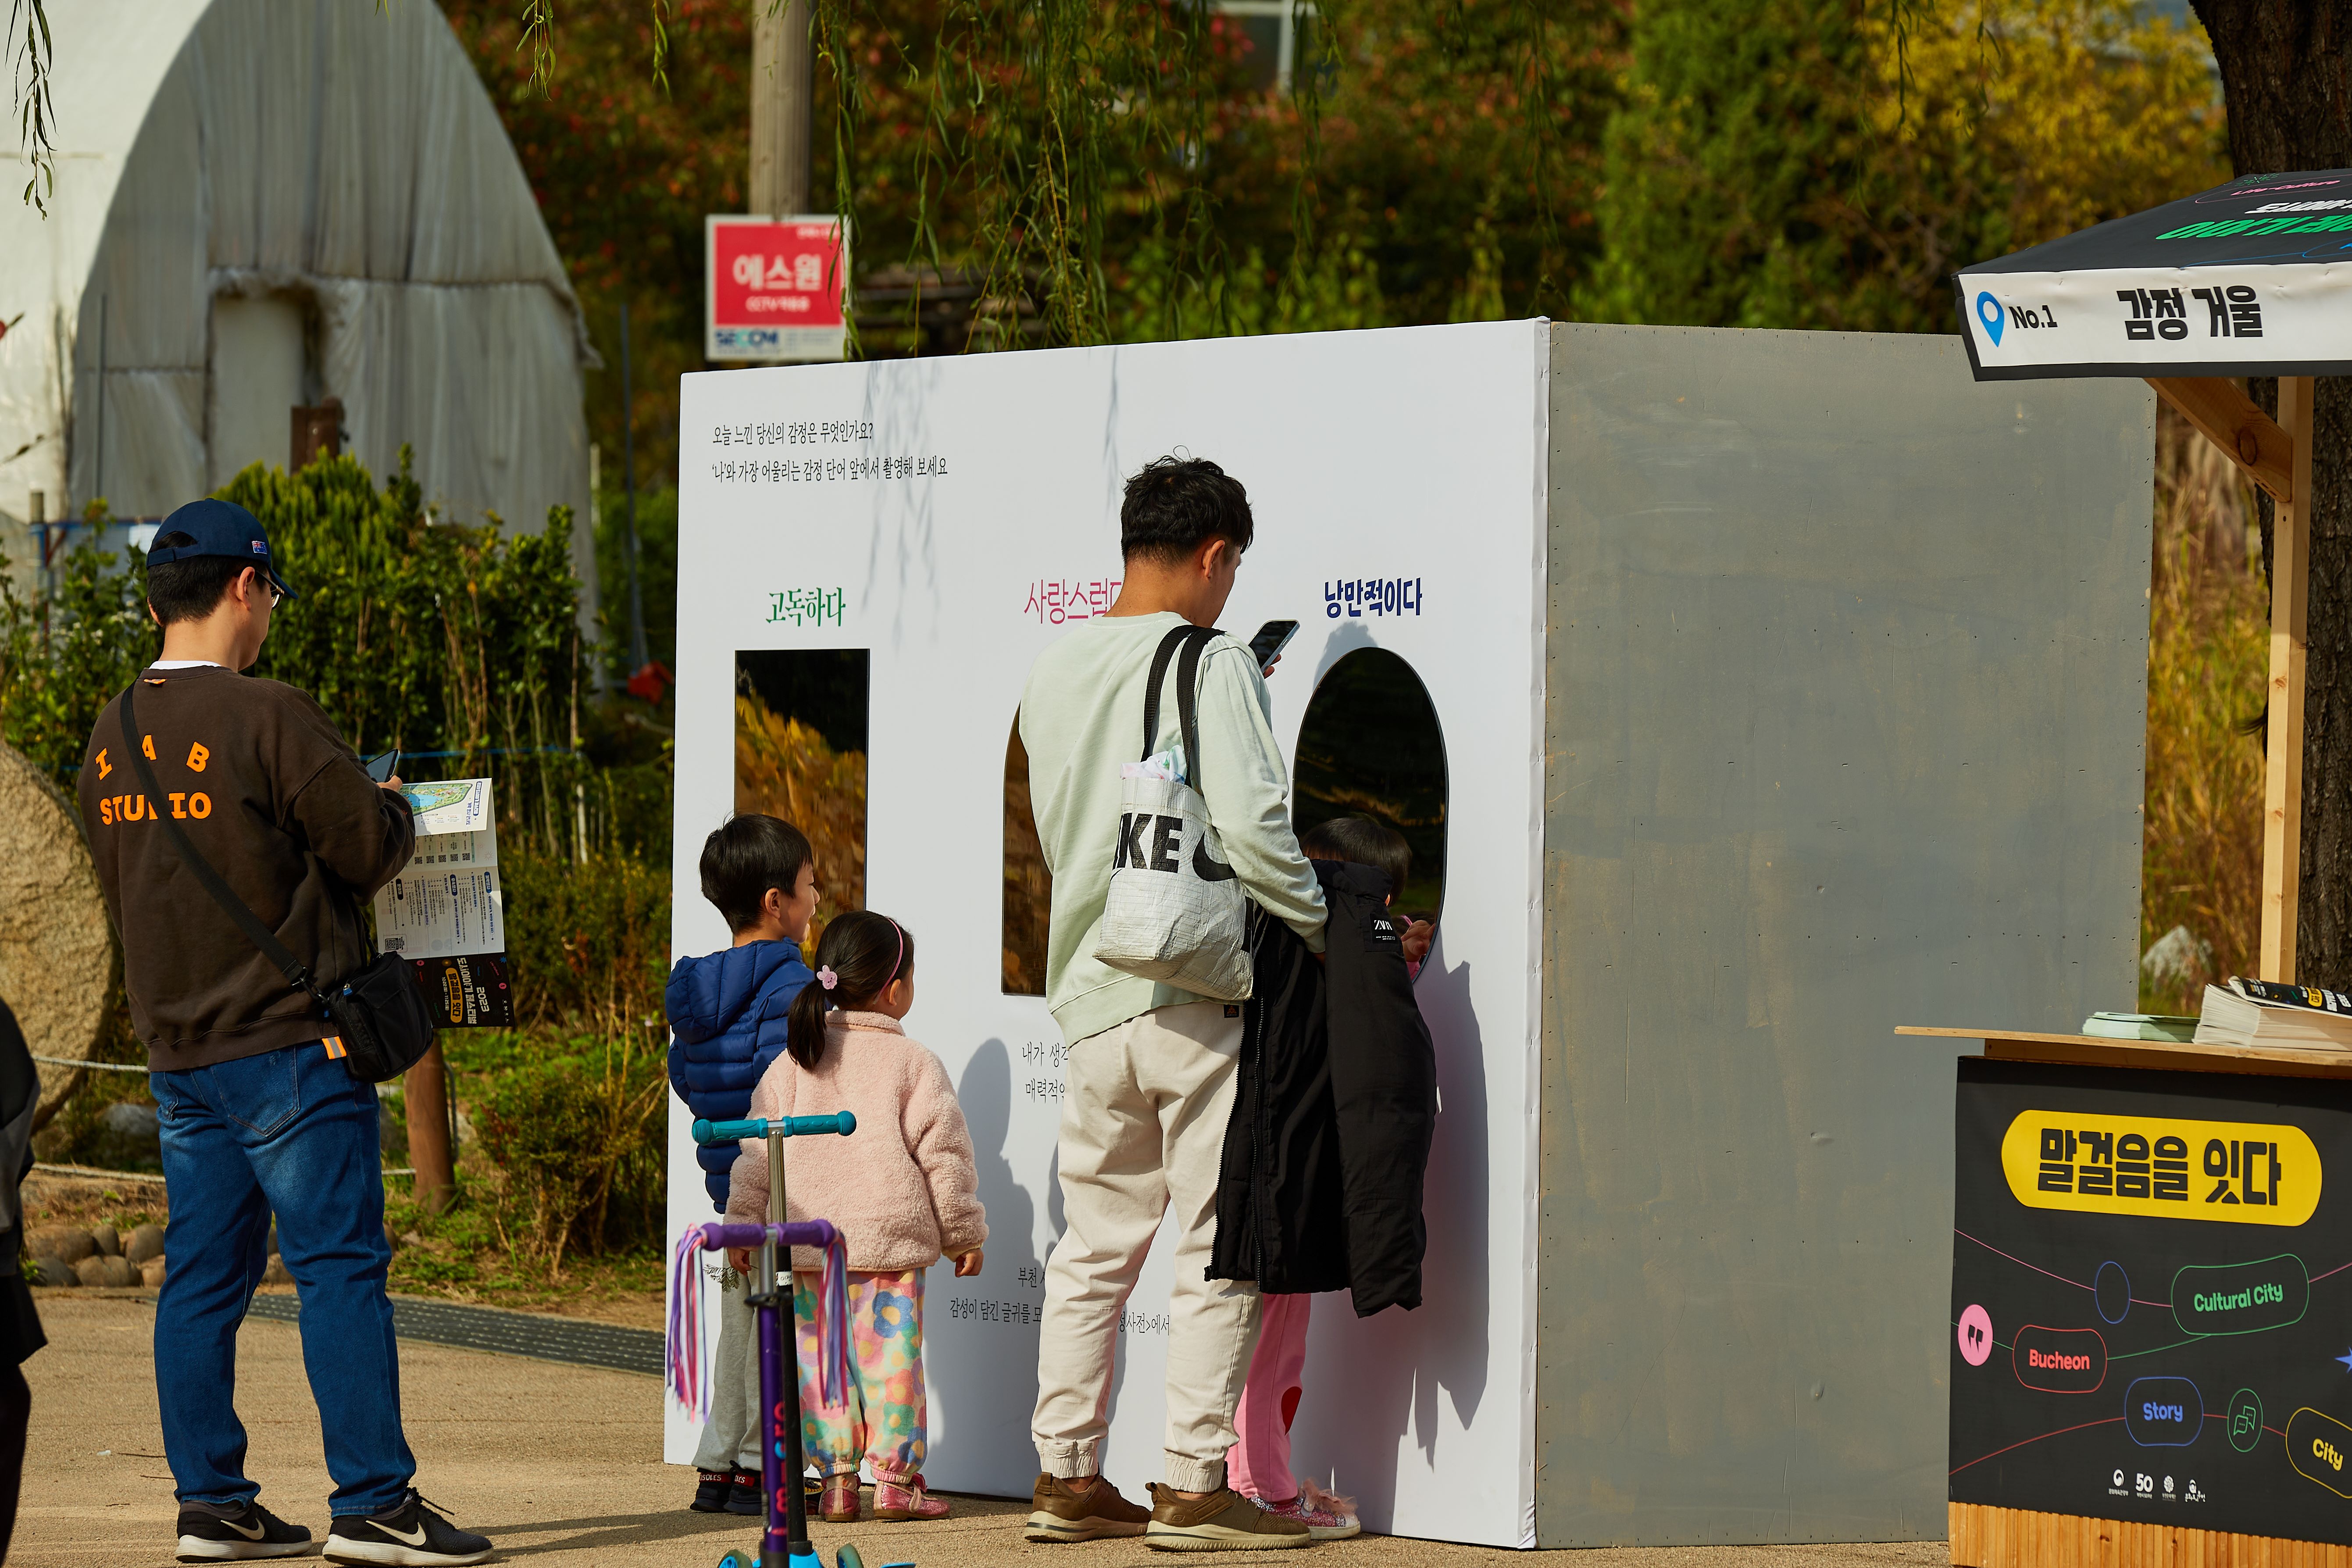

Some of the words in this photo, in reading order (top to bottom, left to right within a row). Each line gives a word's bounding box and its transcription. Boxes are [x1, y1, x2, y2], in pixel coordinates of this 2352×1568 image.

[2244, 199, 2352, 214] 도시이야
[2008, 305, 2058, 329] No.1
[2116, 288, 2188, 341] 감정
[2191, 285, 2263, 338] 거울
[713, 425, 732, 446] 오늘
[734, 423, 753, 445] 느낀
[757, 422, 784, 445] 당신의
[788, 422, 817, 444] 감정은
[820, 420, 873, 443] 무엇인가요?
[739, 461, 759, 483] 가장
[762, 460, 800, 482] 어울리는
[803, 459, 822, 481] 감정
[827, 458, 845, 480] 단어
[850, 457, 879, 480] 앞에서
[883, 456, 913, 479] 촬영해
[917, 455, 948, 476] 보세요
[766, 587, 846, 627] 고독하다
[1324, 577, 1423, 619] 낭만적이다
[1374, 919, 1393, 931] ZARA
[448, 972, 460, 1000] 말걸음을
[457, 957, 474, 993] 도시이야기
[452, 1002, 461, 1017] 잇다
[476, 987, 490, 1012] 2023
[1022, 1041, 1044, 1067] 내가
[2038, 1129, 2188, 1201] 말걸음을
[2203, 1139, 2282, 1206] 잇다
[1017, 1267, 1037, 1288] 부천
[950, 1297, 977, 1320] 감성이
[981, 1300, 999, 1321] 담긴
[1001, 1302, 1031, 1324] 글귀를
[2194, 1288, 2252, 1312] Cultural
[2253, 1283, 2284, 1305] City
[2028, 1348, 2091, 1371] Bucheon
[2142, 1401, 2184, 1423] Story
[2312, 1438, 2344, 1472] City
[2135, 1472, 2154, 1493] 50
